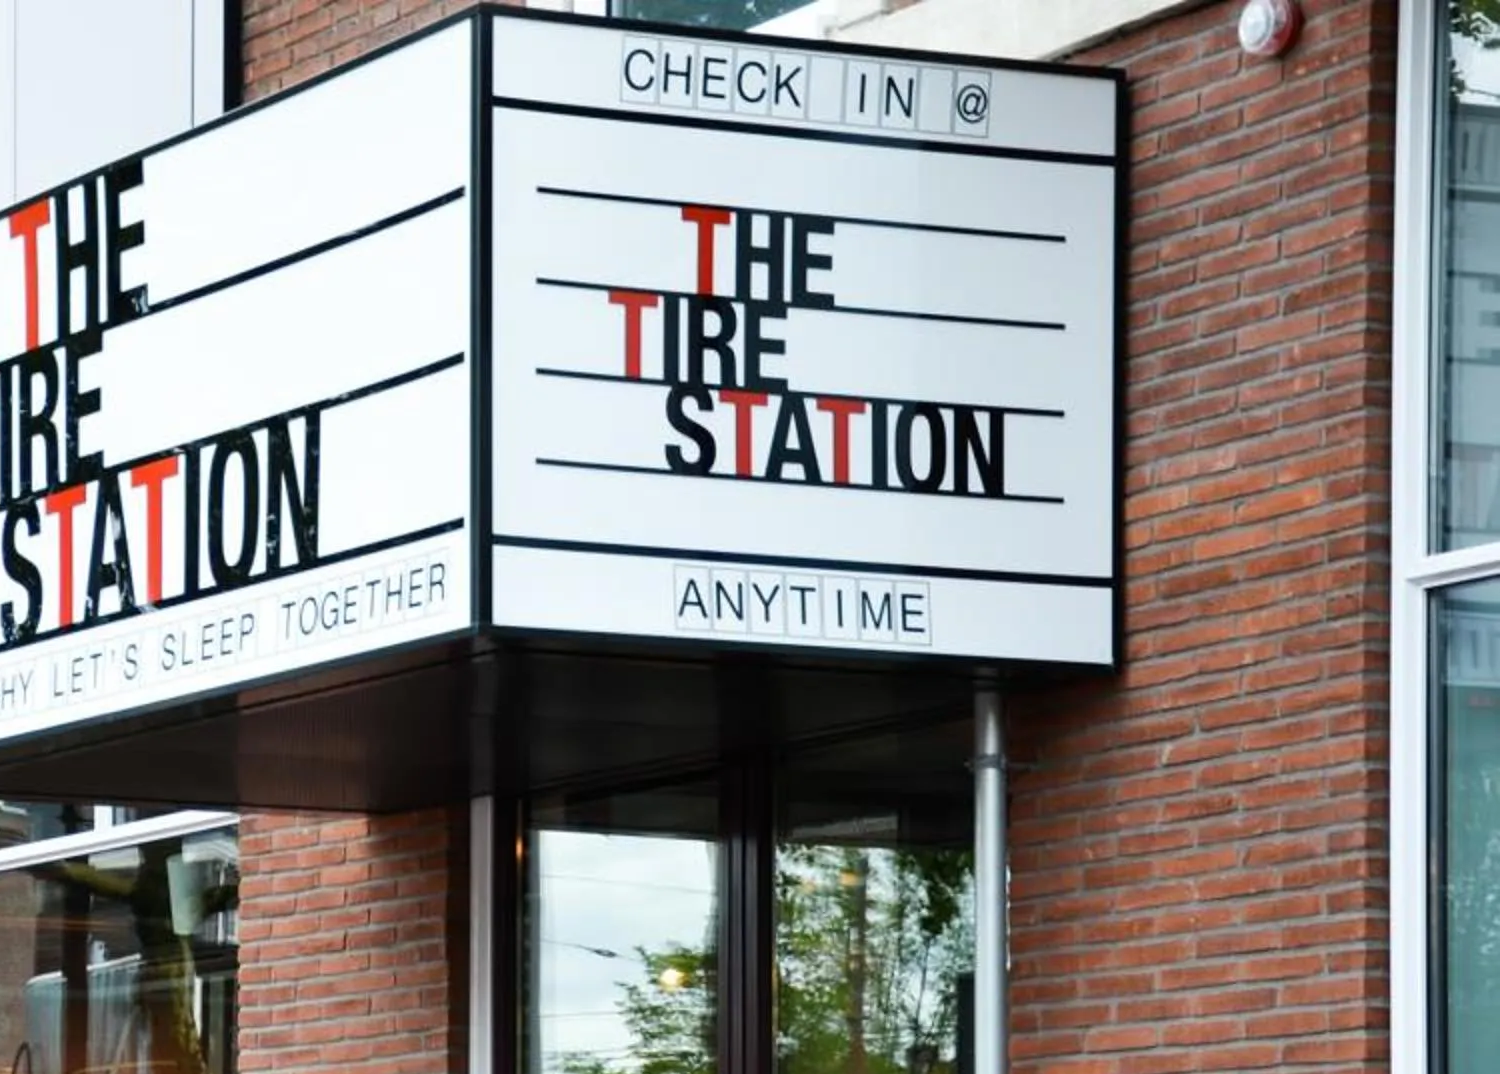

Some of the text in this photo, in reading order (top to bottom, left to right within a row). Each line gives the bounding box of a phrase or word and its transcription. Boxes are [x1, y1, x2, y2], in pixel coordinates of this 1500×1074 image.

[623, 47, 803, 107] CHECK
[858, 73, 914, 118] IN
[9, 157, 148, 351] THE
[681, 204, 835, 307] THE
[609, 290, 788, 389] TIRE
[664, 384, 1004, 496] STATION
[0, 408, 320, 646] STATION
[53, 644, 138, 697] LET'S
[161, 613, 255, 671] SLEEP
[282, 563, 446, 640] TOGETHER
[677, 578, 927, 633] ANYTIME
